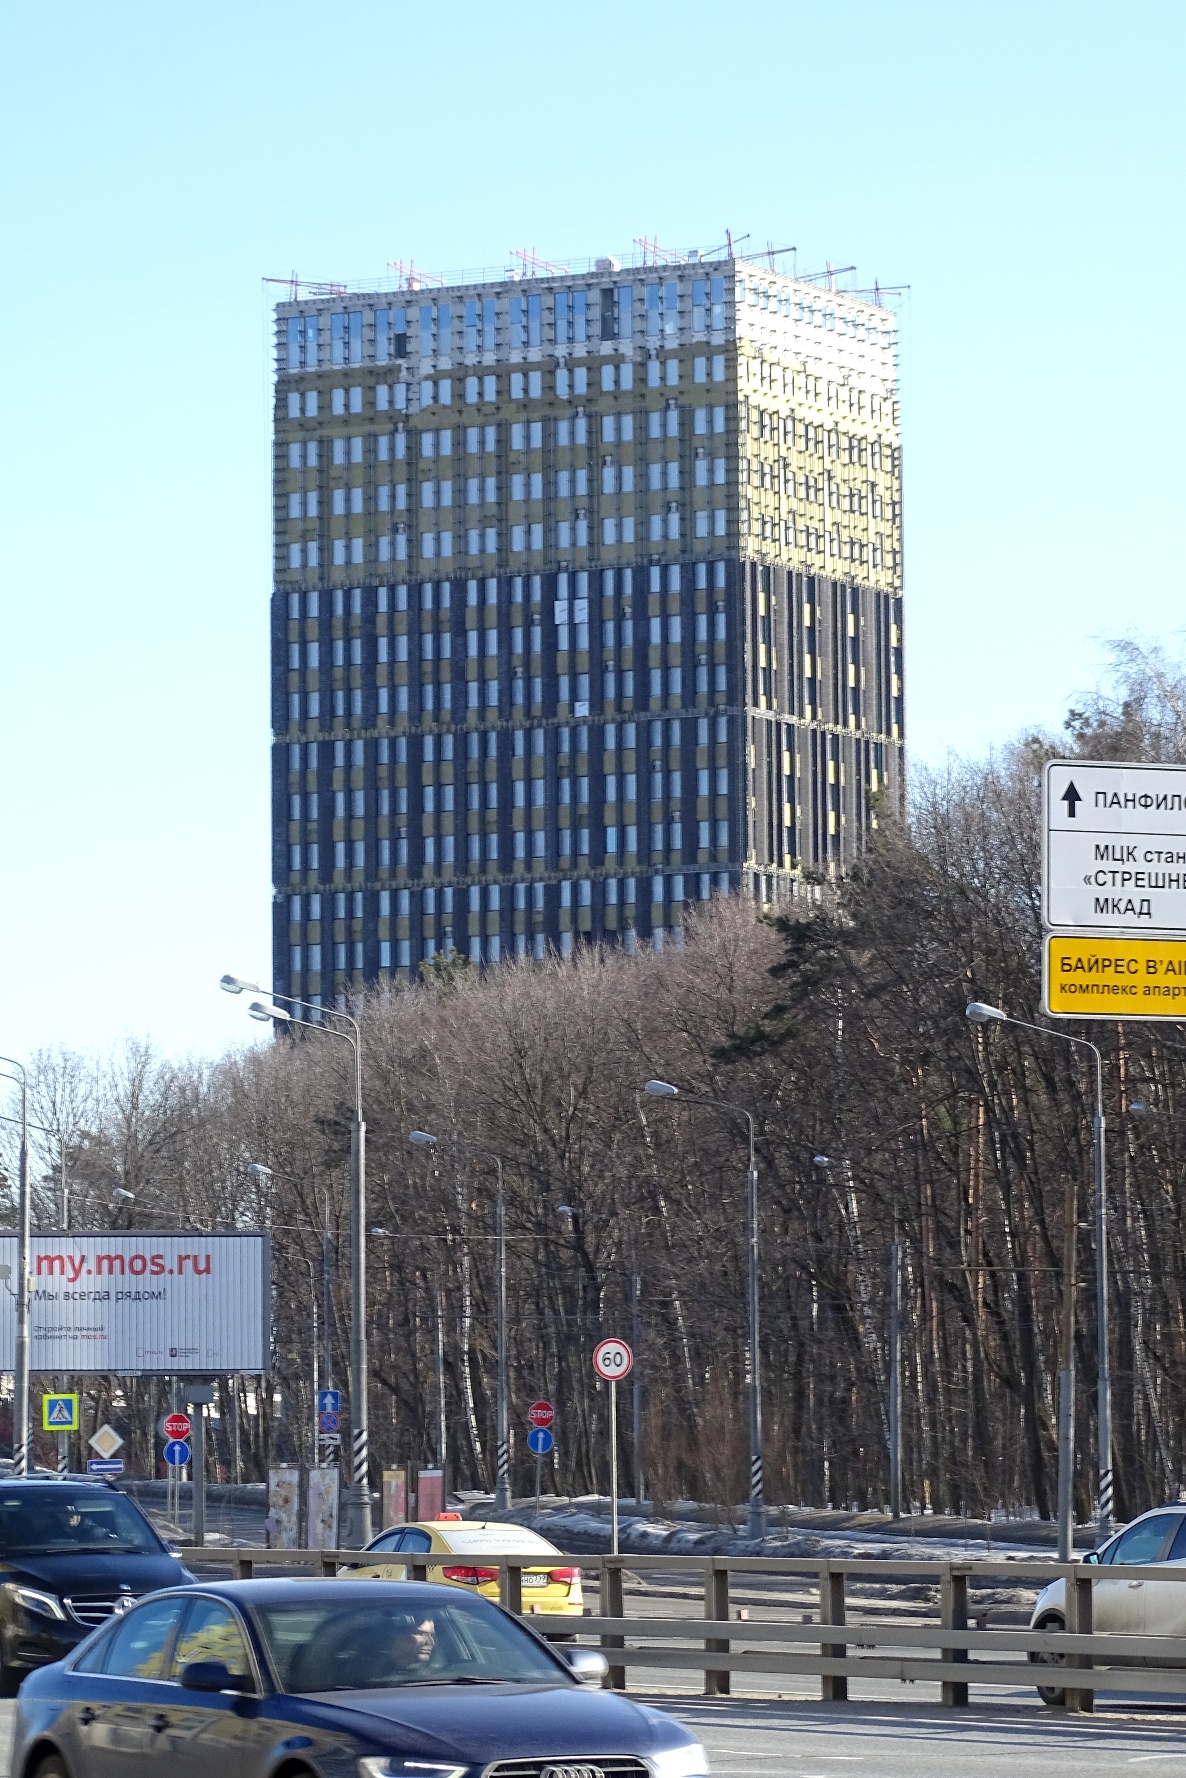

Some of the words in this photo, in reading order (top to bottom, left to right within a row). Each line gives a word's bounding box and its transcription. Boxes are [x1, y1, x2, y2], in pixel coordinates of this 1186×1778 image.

[1094, 791, 1186, 811] ПАНФИЛ
[1094, 844, 1137, 865] МЦК
[1094, 897, 1151, 918] МКАД
[1060, 954, 1139, 974] БАЙРЕС
[1060, 983, 1138, 995] комплекс
[36, 1253, 212, 1283] my.mos.ru
[34, 1289, 59, 1301] Мы
[64, 1290, 110, 1302] всегда
[115, 1288, 166, 1303] рядом!
[602, 1351, 623, 1368] 60
[530, 1409, 554, 1419] STOP
[165, 1422, 190, 1431] STOP
